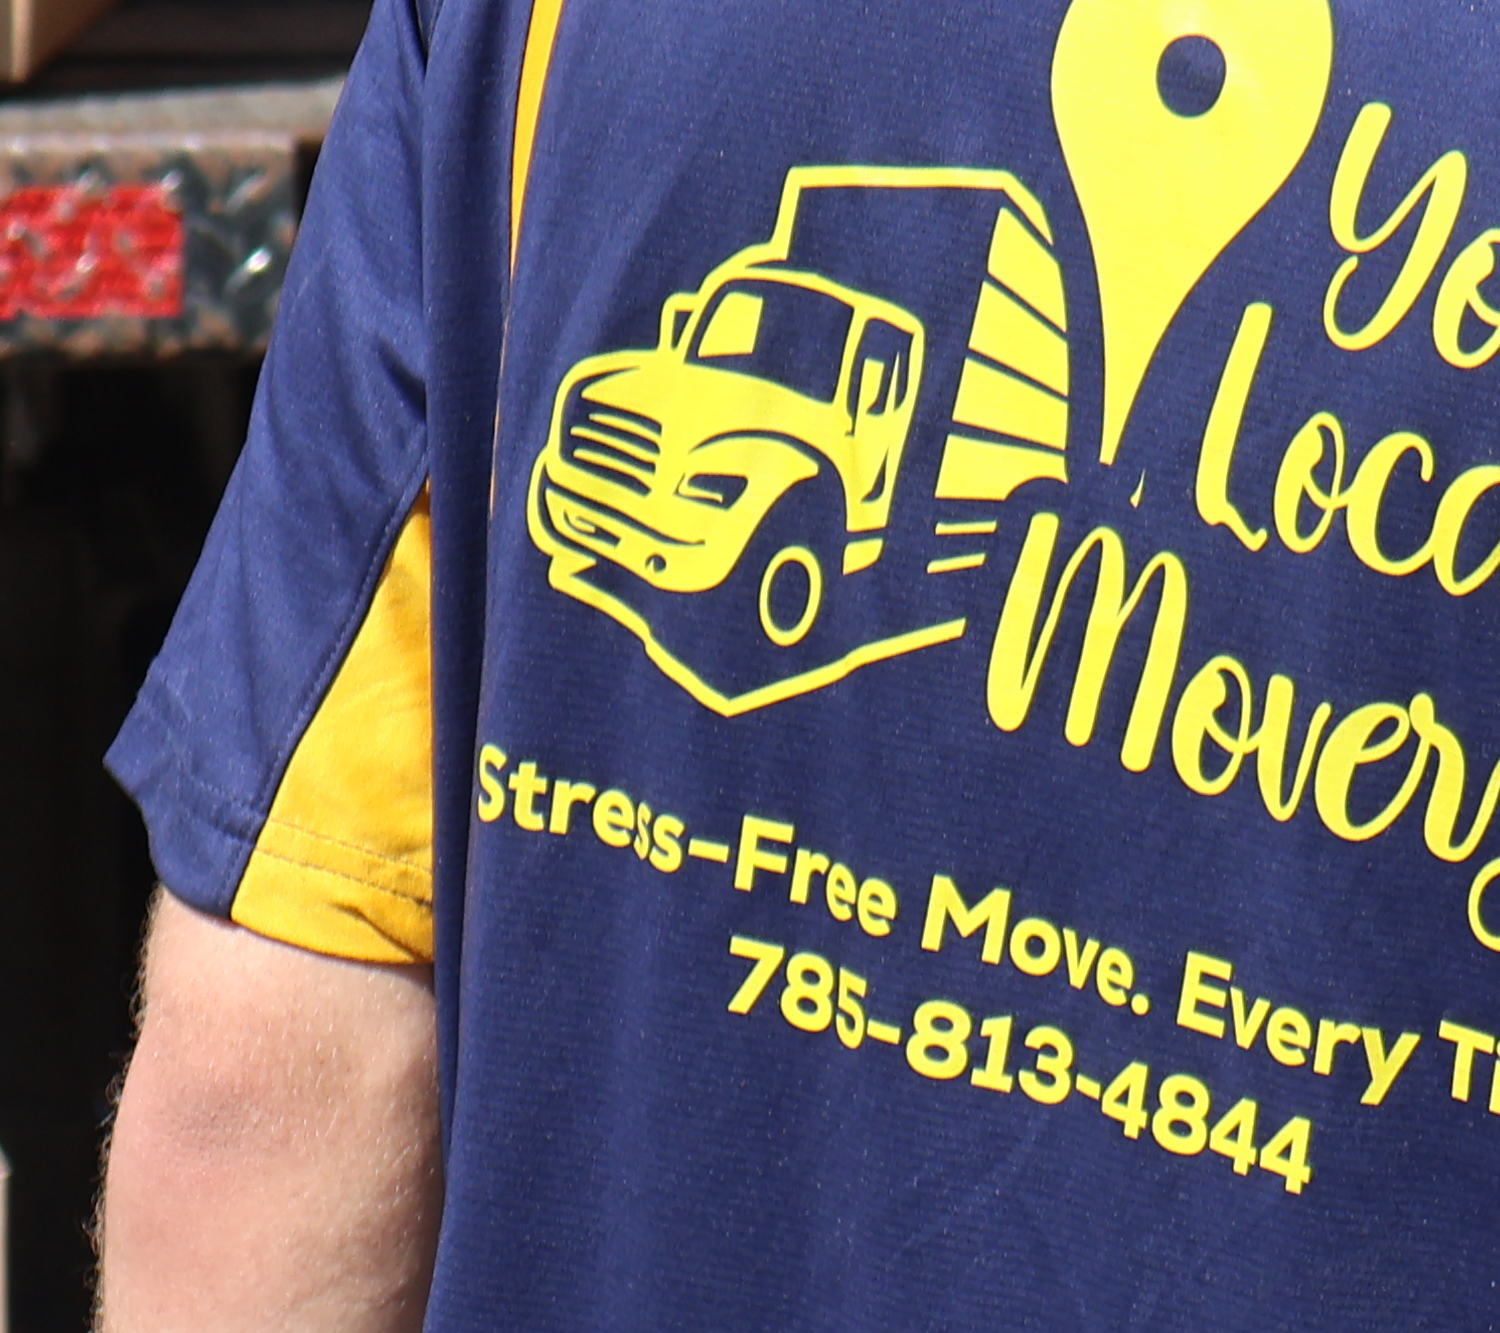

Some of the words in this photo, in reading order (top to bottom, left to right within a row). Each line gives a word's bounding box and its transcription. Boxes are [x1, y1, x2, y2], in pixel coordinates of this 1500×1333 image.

[476, 745, 897, 935] Stress-Free
[921, 876, 1150, 1017] Move.
[1176, 953, 1421, 1104] Every
[727, 937, 1312, 1194] 785-813-4844
